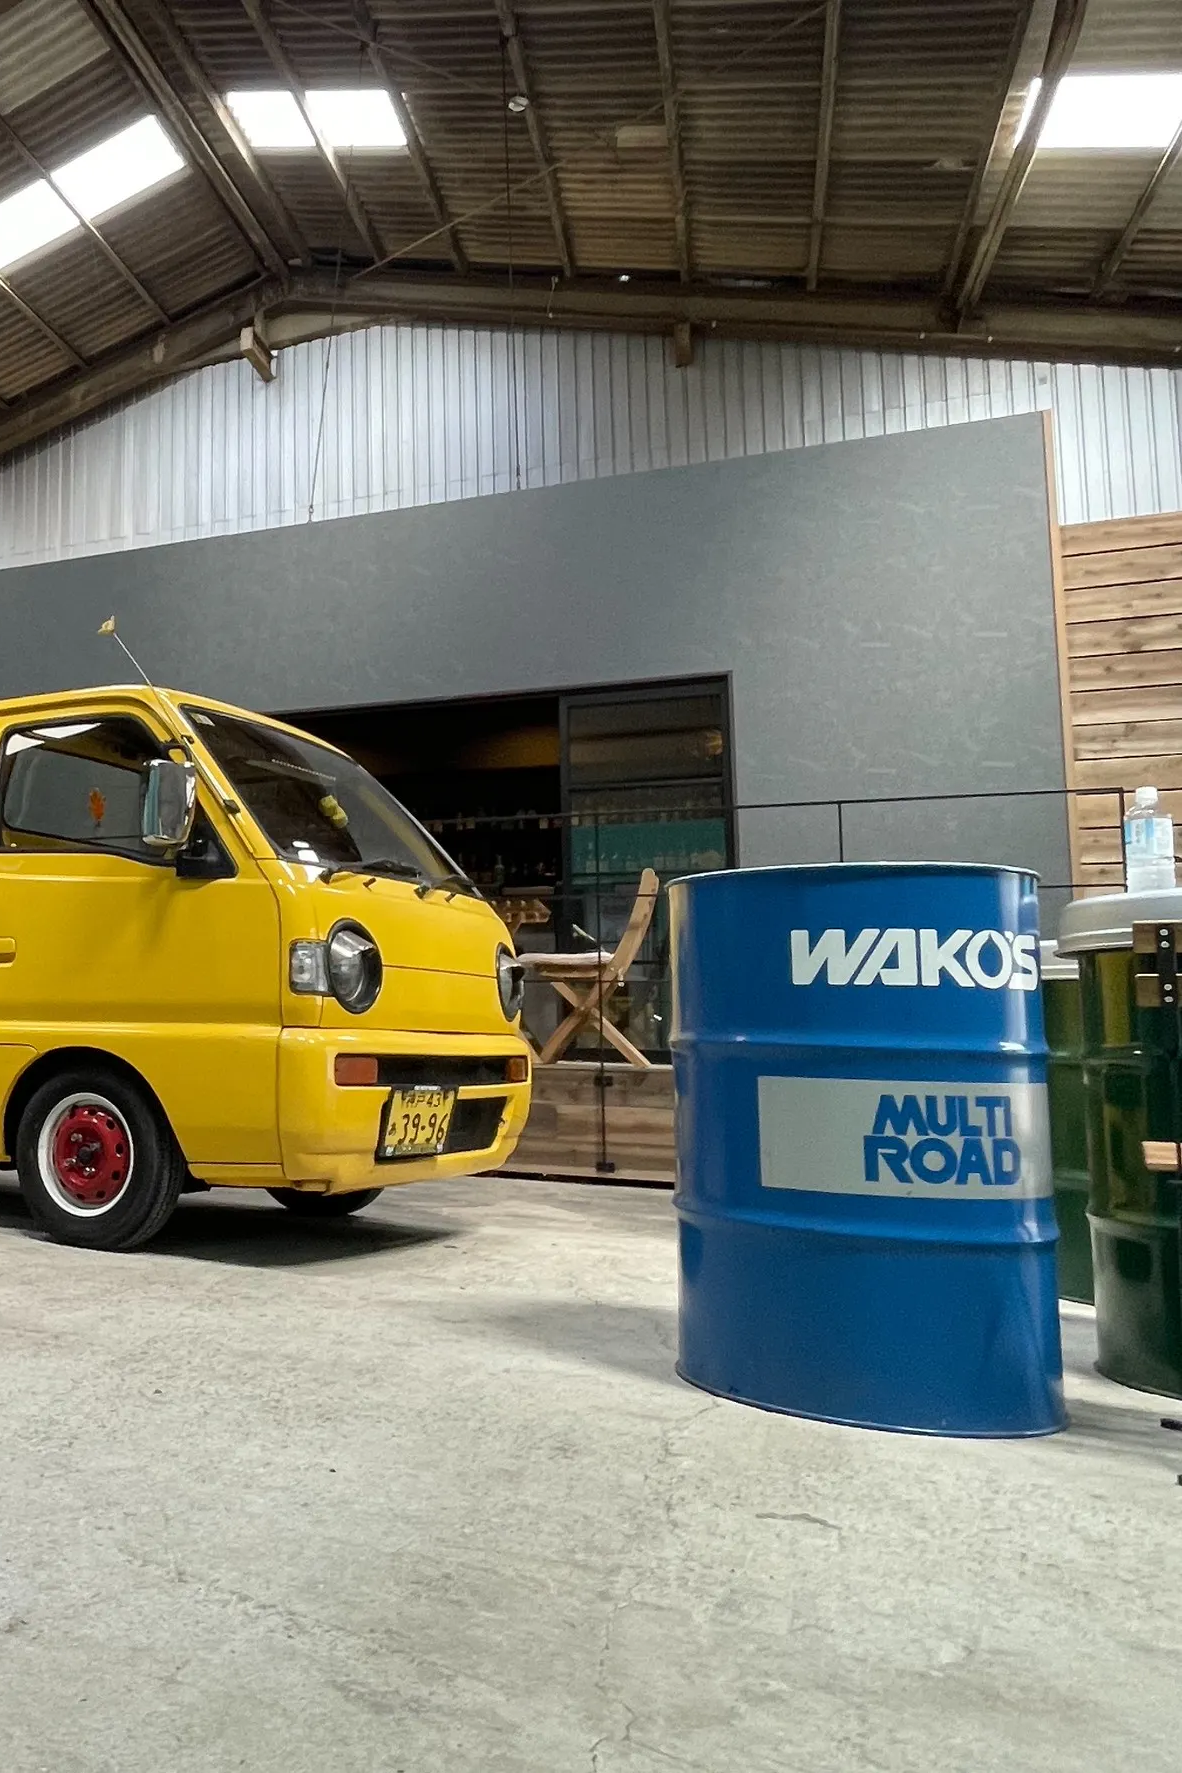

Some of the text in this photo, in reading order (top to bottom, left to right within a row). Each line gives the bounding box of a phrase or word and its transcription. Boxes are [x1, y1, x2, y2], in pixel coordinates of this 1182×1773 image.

[790, 928, 1038, 990] WAKO'S
[872, 1094, 1013, 1137] MULTI
[863, 1135, 1022, 1185] ROAD
